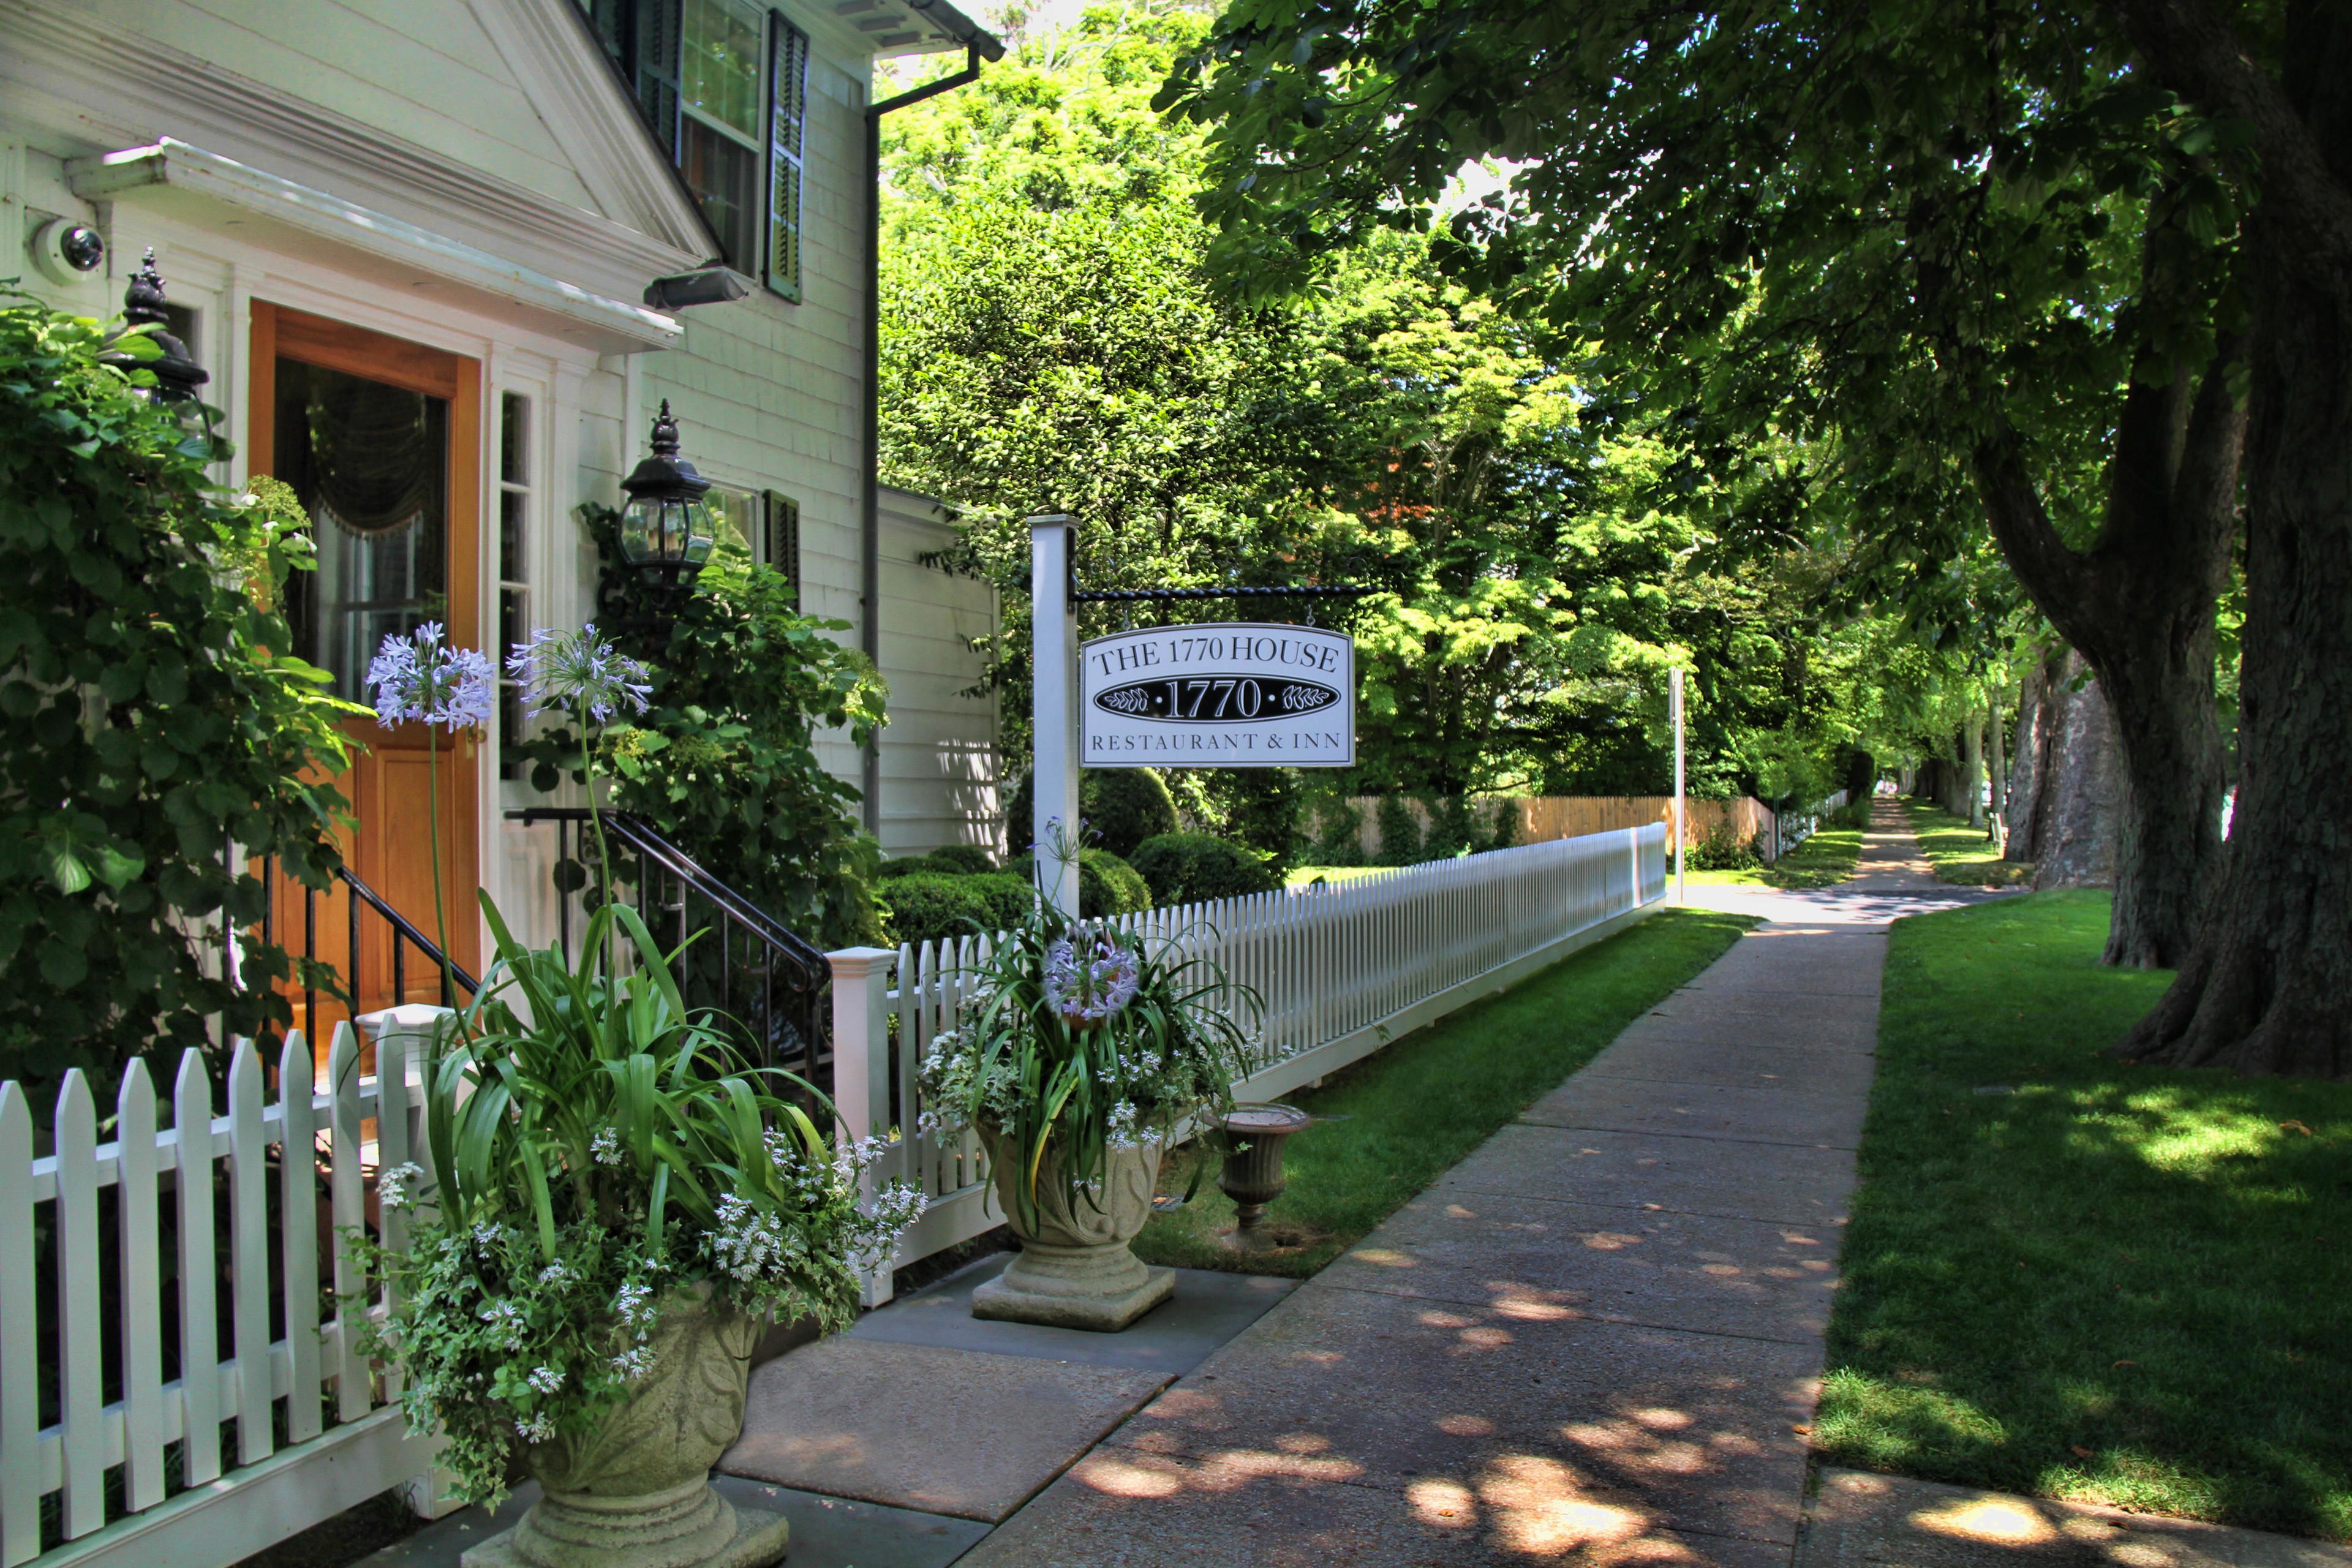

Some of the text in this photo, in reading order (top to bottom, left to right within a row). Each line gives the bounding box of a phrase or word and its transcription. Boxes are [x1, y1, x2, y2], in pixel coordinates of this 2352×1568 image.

[1093, 636, 1340, 675] THE 1770 HOUSE
[1165, 679, 1262, 718] 1770
[1092, 733, 1340, 750] RESTAURANT & INN
